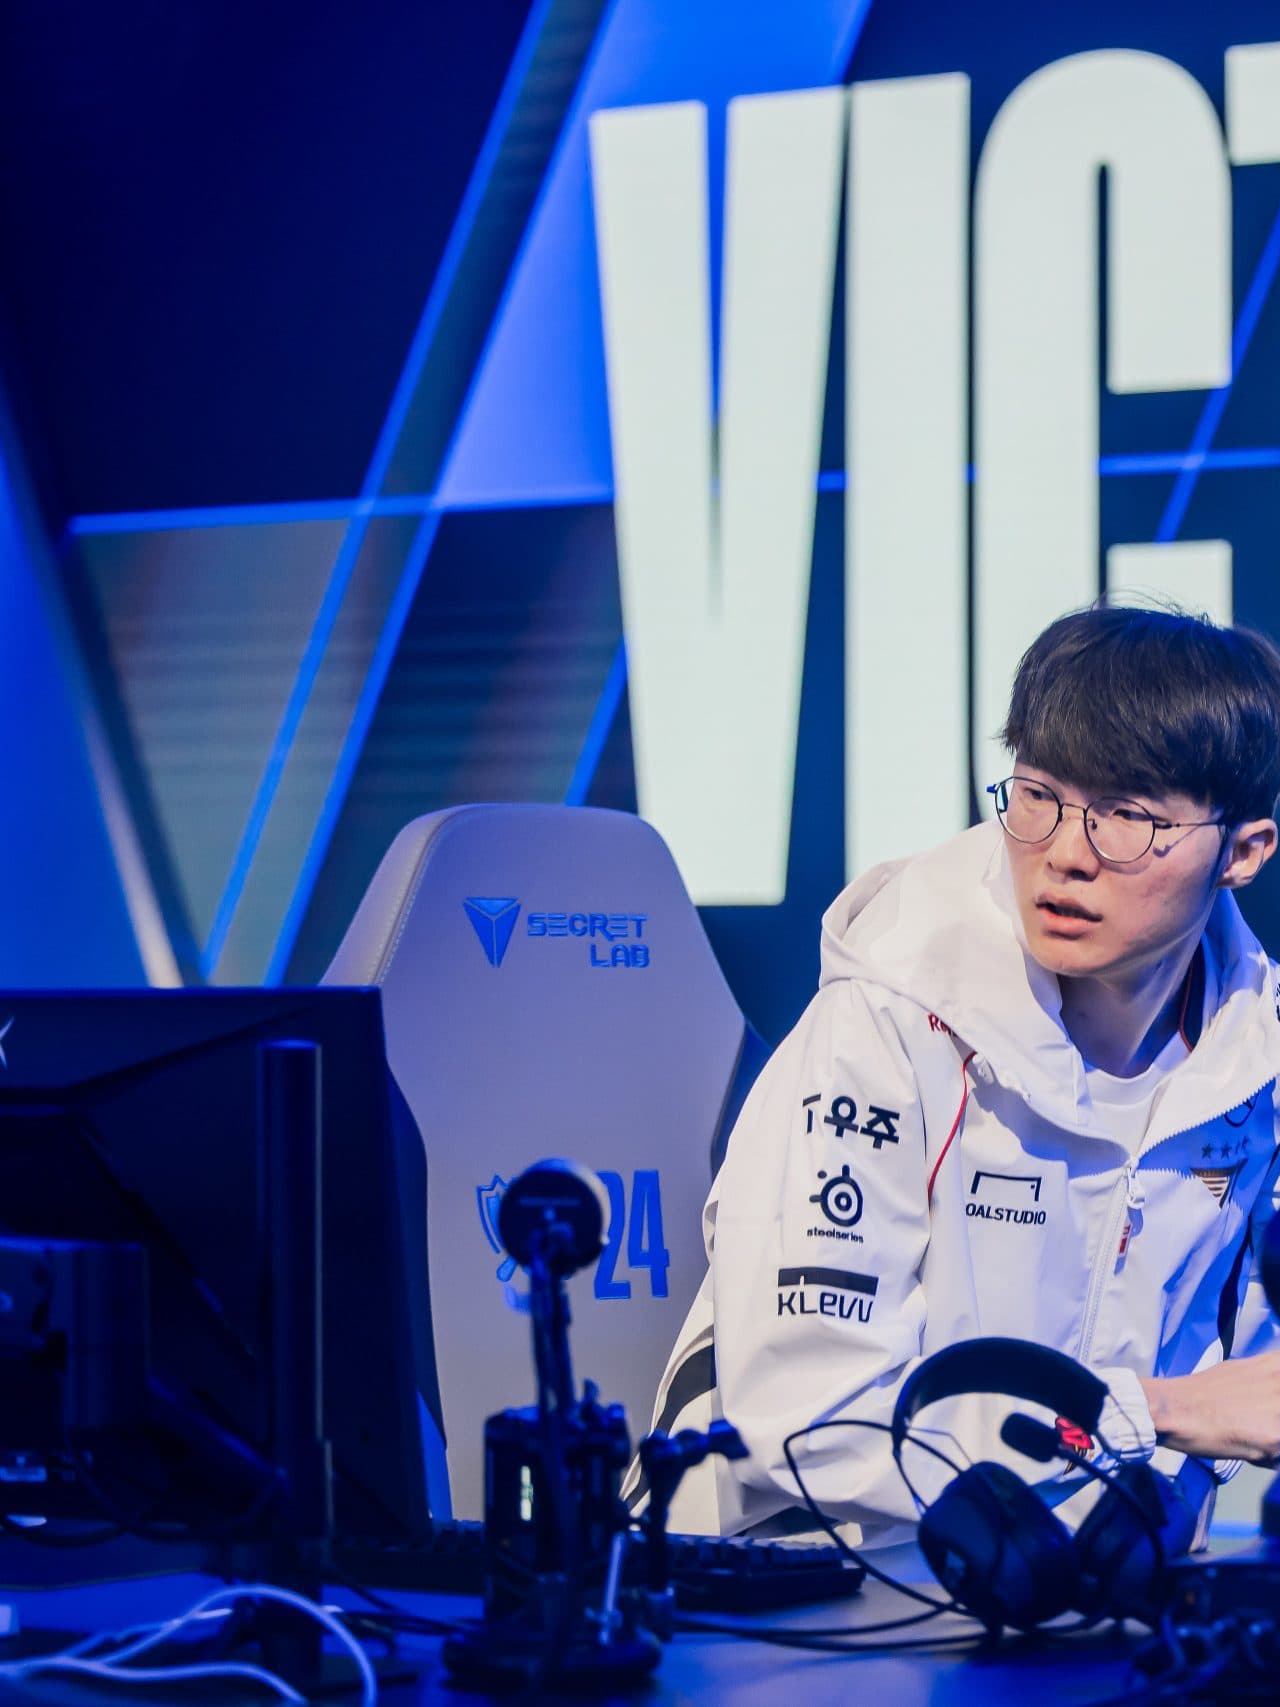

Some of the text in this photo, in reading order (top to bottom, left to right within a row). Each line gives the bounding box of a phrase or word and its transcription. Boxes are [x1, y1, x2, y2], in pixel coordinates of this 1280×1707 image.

[527, 912, 648, 942] SECRET
[590, 943, 650, 969] LAB
[965, 1202, 1047, 1225] OALSTUDIO
[594, 1169, 670, 1300] 24
